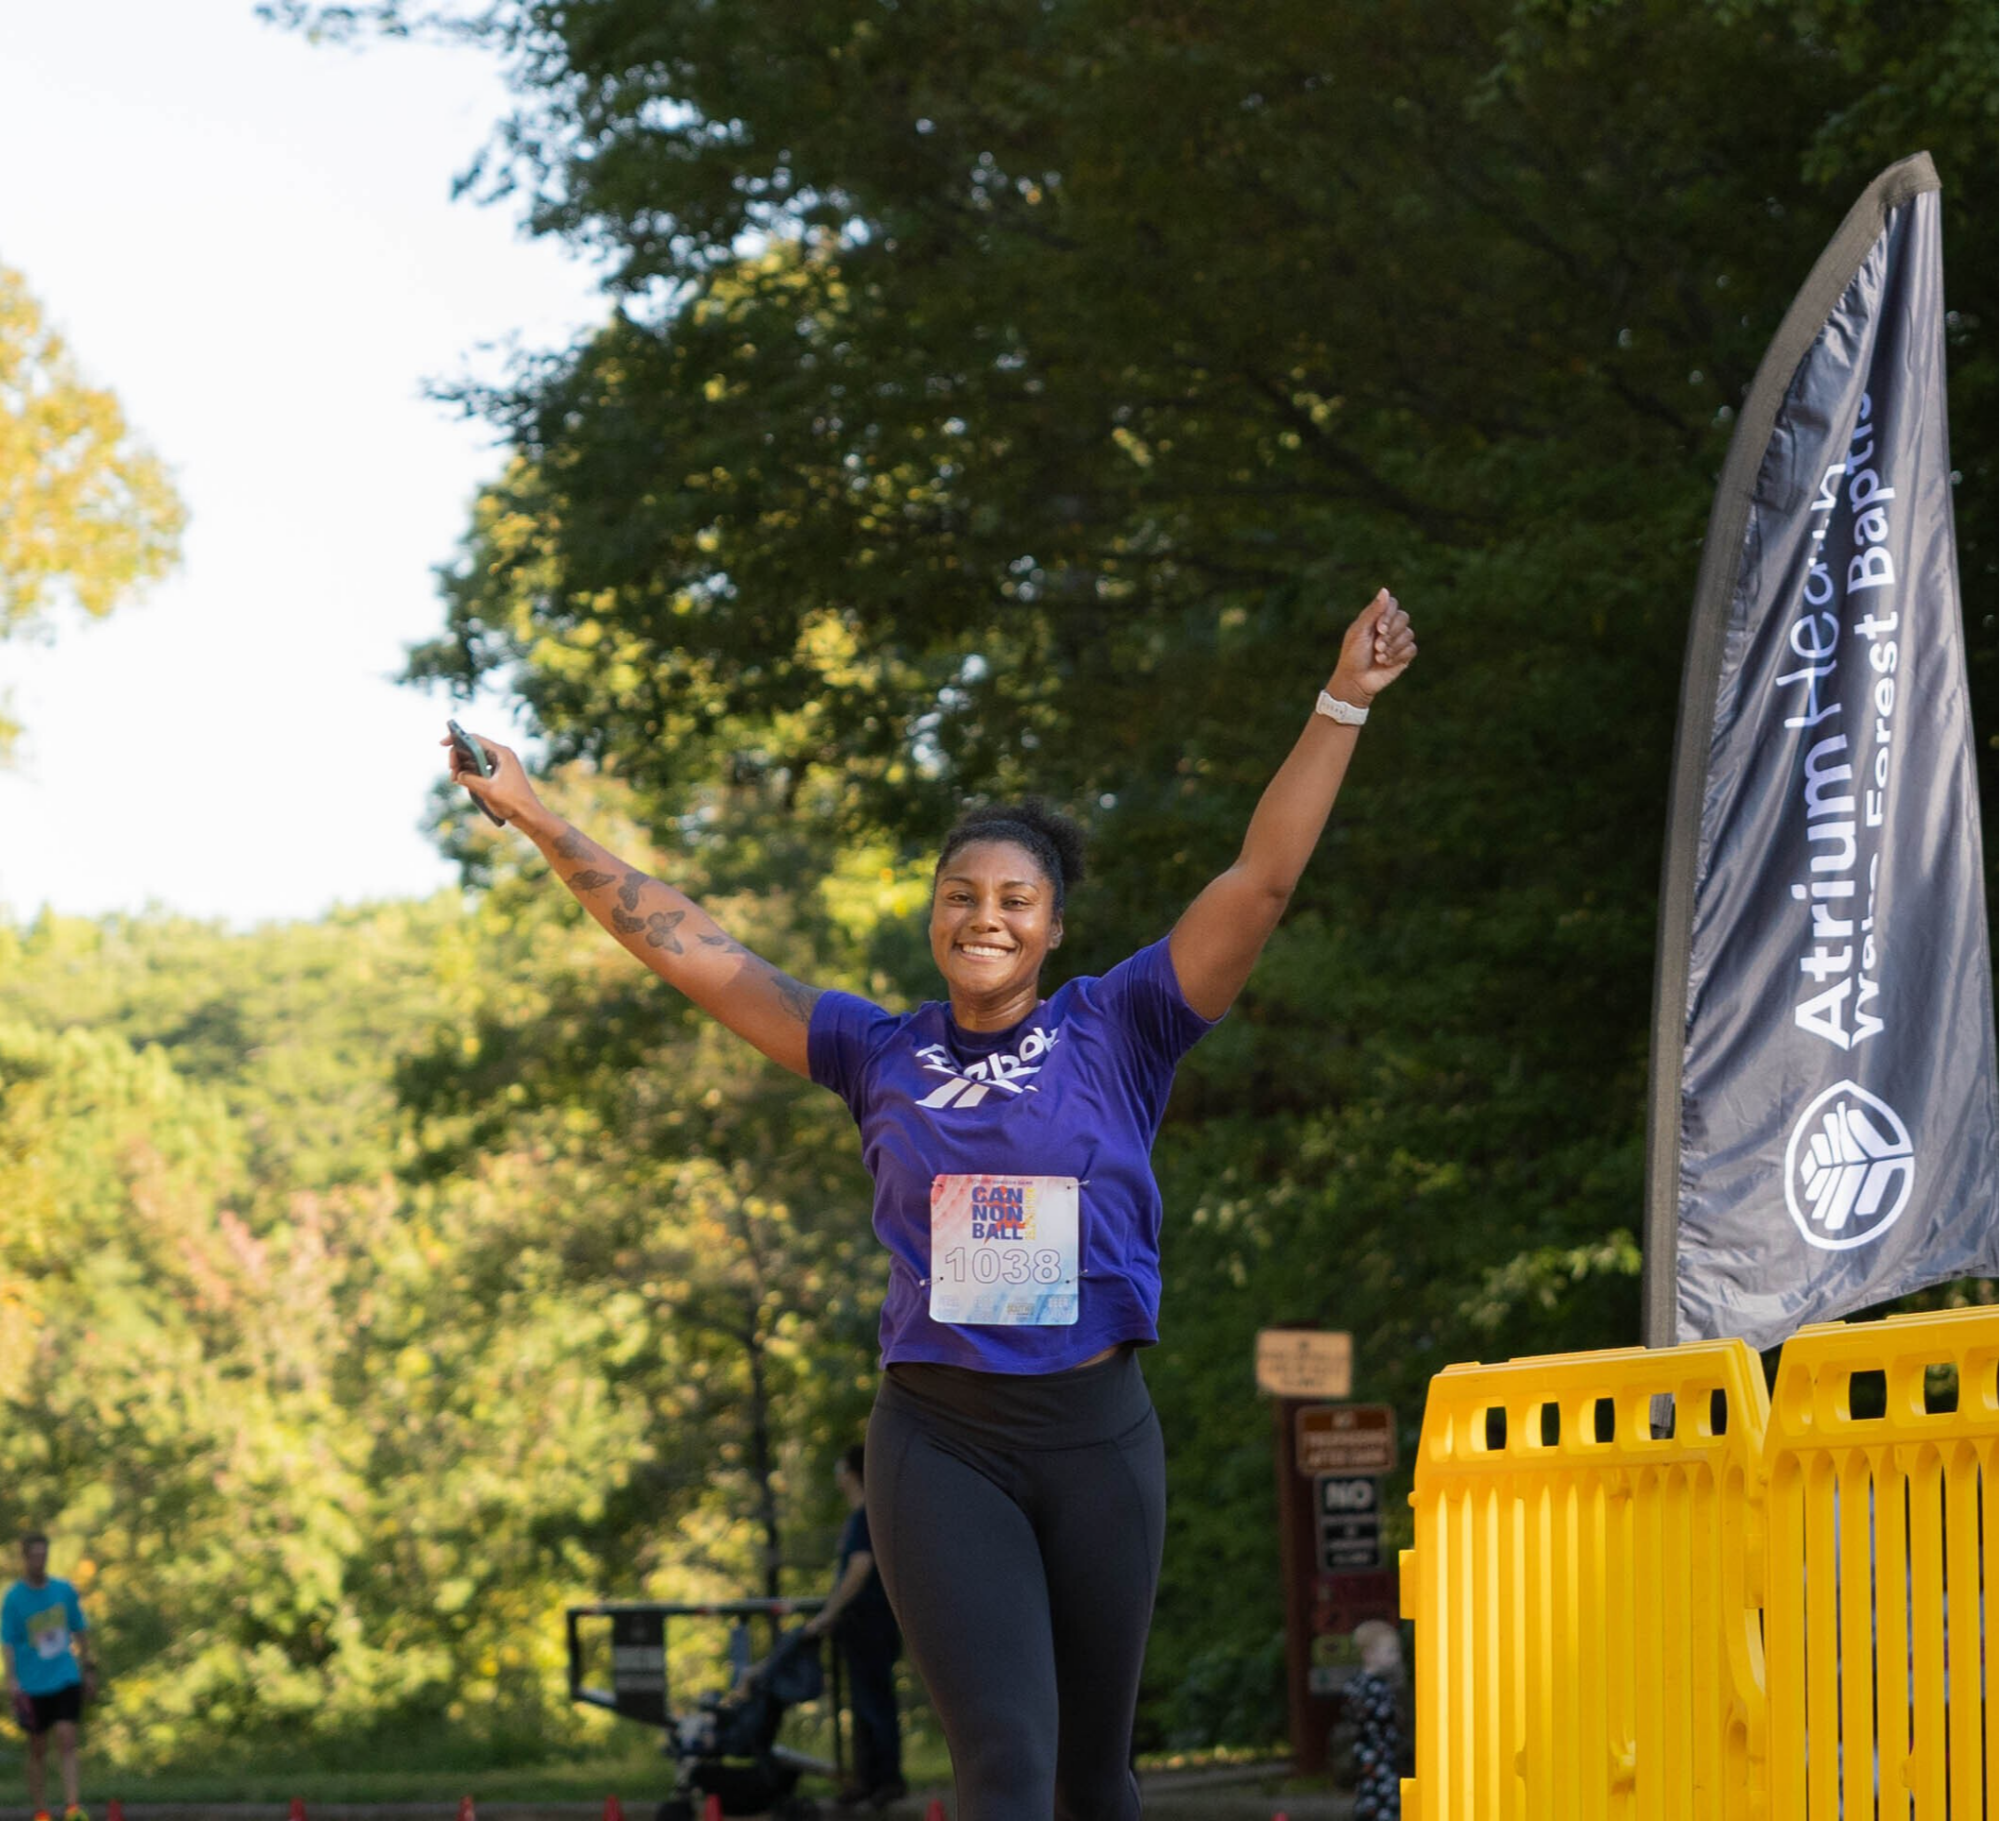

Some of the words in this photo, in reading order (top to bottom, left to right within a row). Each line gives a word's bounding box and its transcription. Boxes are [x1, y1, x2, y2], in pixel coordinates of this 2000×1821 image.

[1791, 734, 1857, 1051] Atrium
[971, 1186, 1023, 1204] CAN
[971, 1204, 1023, 1222] NON
[971, 1222, 1023, 1240] BALL
[945, 1247, 1062, 1285] 1038
[1326, 1480, 1373, 1509] NO
